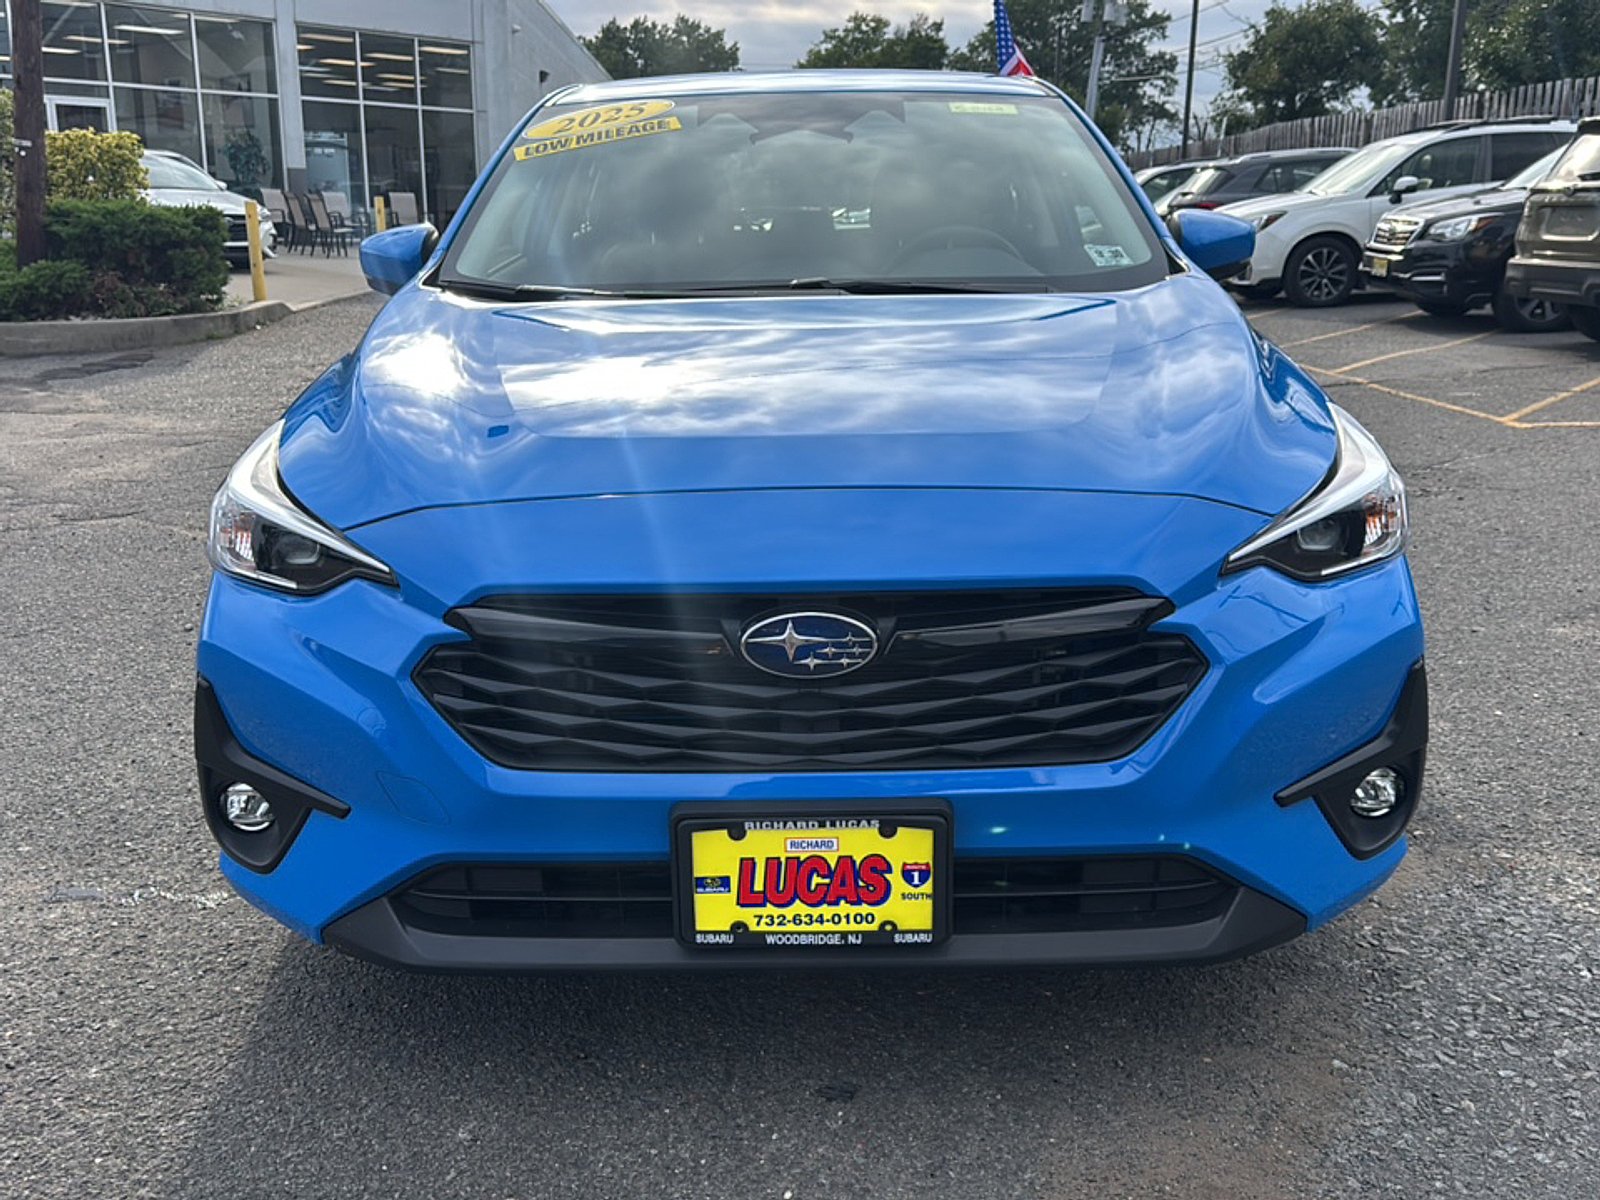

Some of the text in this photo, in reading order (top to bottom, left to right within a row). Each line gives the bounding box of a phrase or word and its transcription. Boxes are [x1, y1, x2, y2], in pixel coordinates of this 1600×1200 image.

[553, 102, 648, 133] 2025
[524, 119, 669, 157] LOW MILEAGE
[744, 819, 880, 830] RICHARD LUCAS
[790, 840, 834, 849] RICHARD
[737, 854, 893, 908] LUCAS
[911, 871, 922, 885] 1
[901, 892, 932, 900] SOUTH
[753, 912, 875, 927] 732-634-0100
[695, 933, 734, 944] SUBARU
[848, 933, 862, 945] NJ
[894, 932, 933, 943] SUBARU
